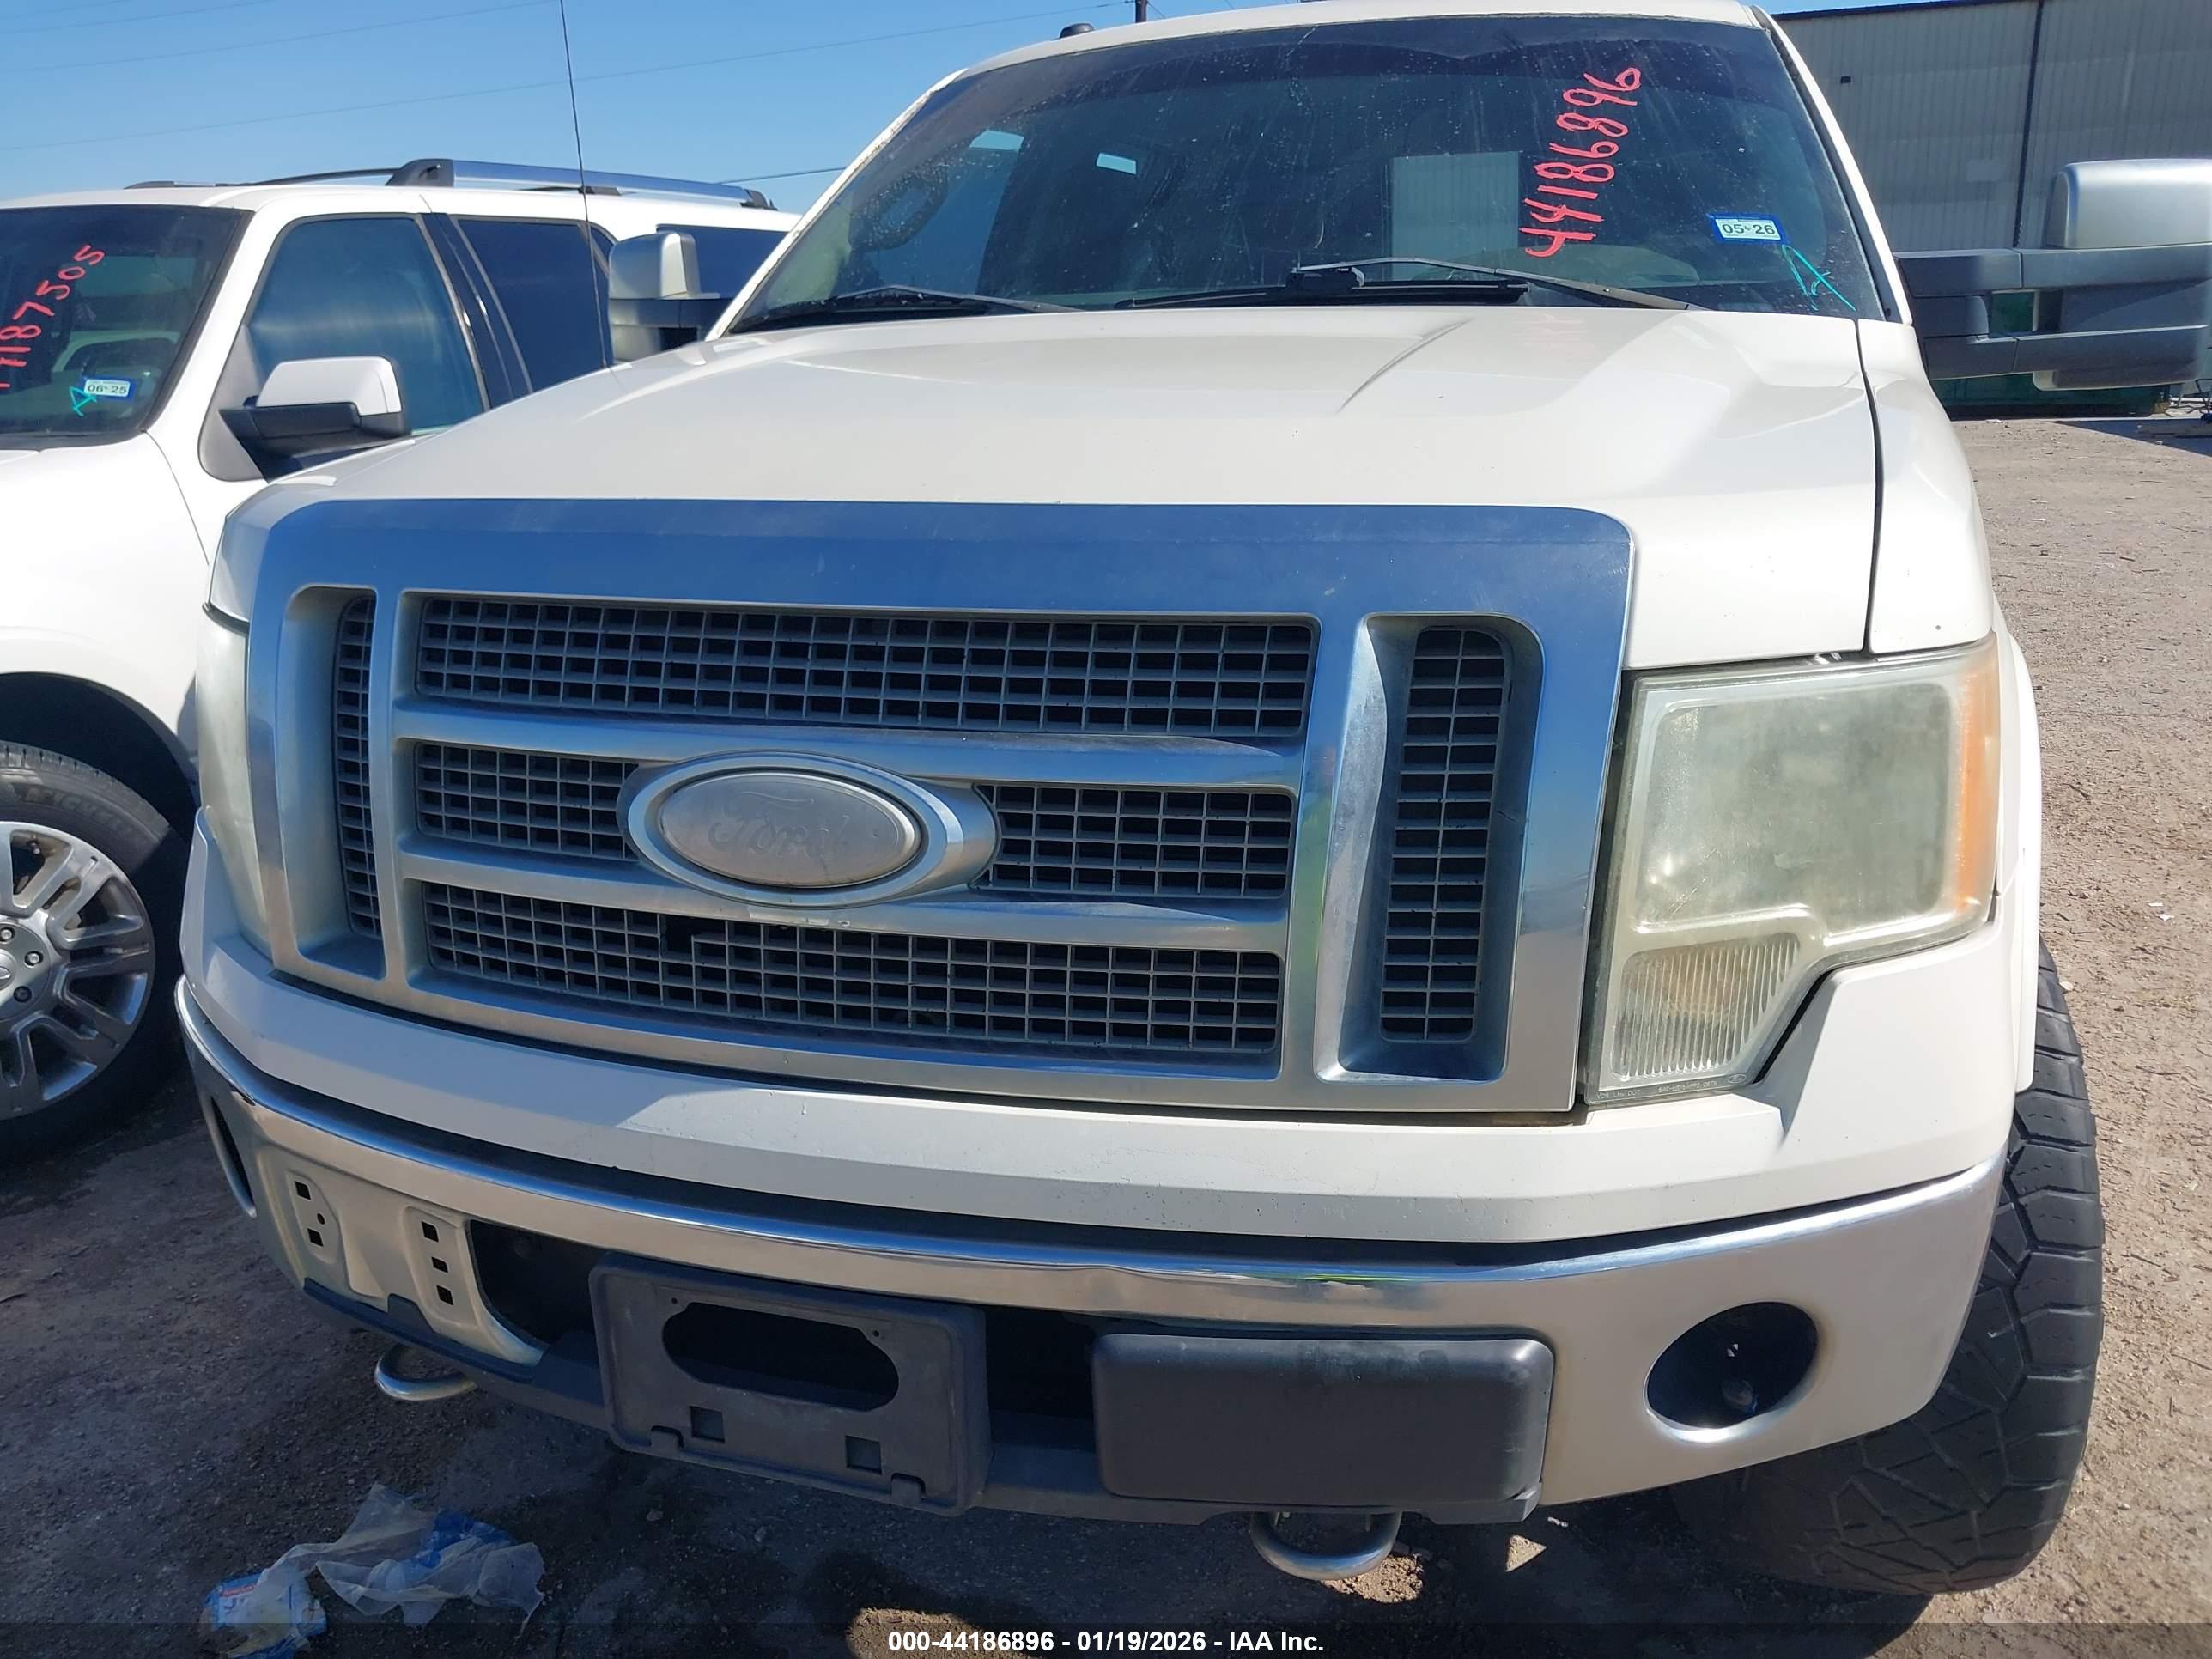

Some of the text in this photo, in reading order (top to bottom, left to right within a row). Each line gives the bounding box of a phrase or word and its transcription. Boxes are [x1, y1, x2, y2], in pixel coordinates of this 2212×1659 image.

[1519, 68, 1641, 257] 44186896
[1722, 224, 1775, 234] 05 26
[0, 244, 105, 389] 187505
